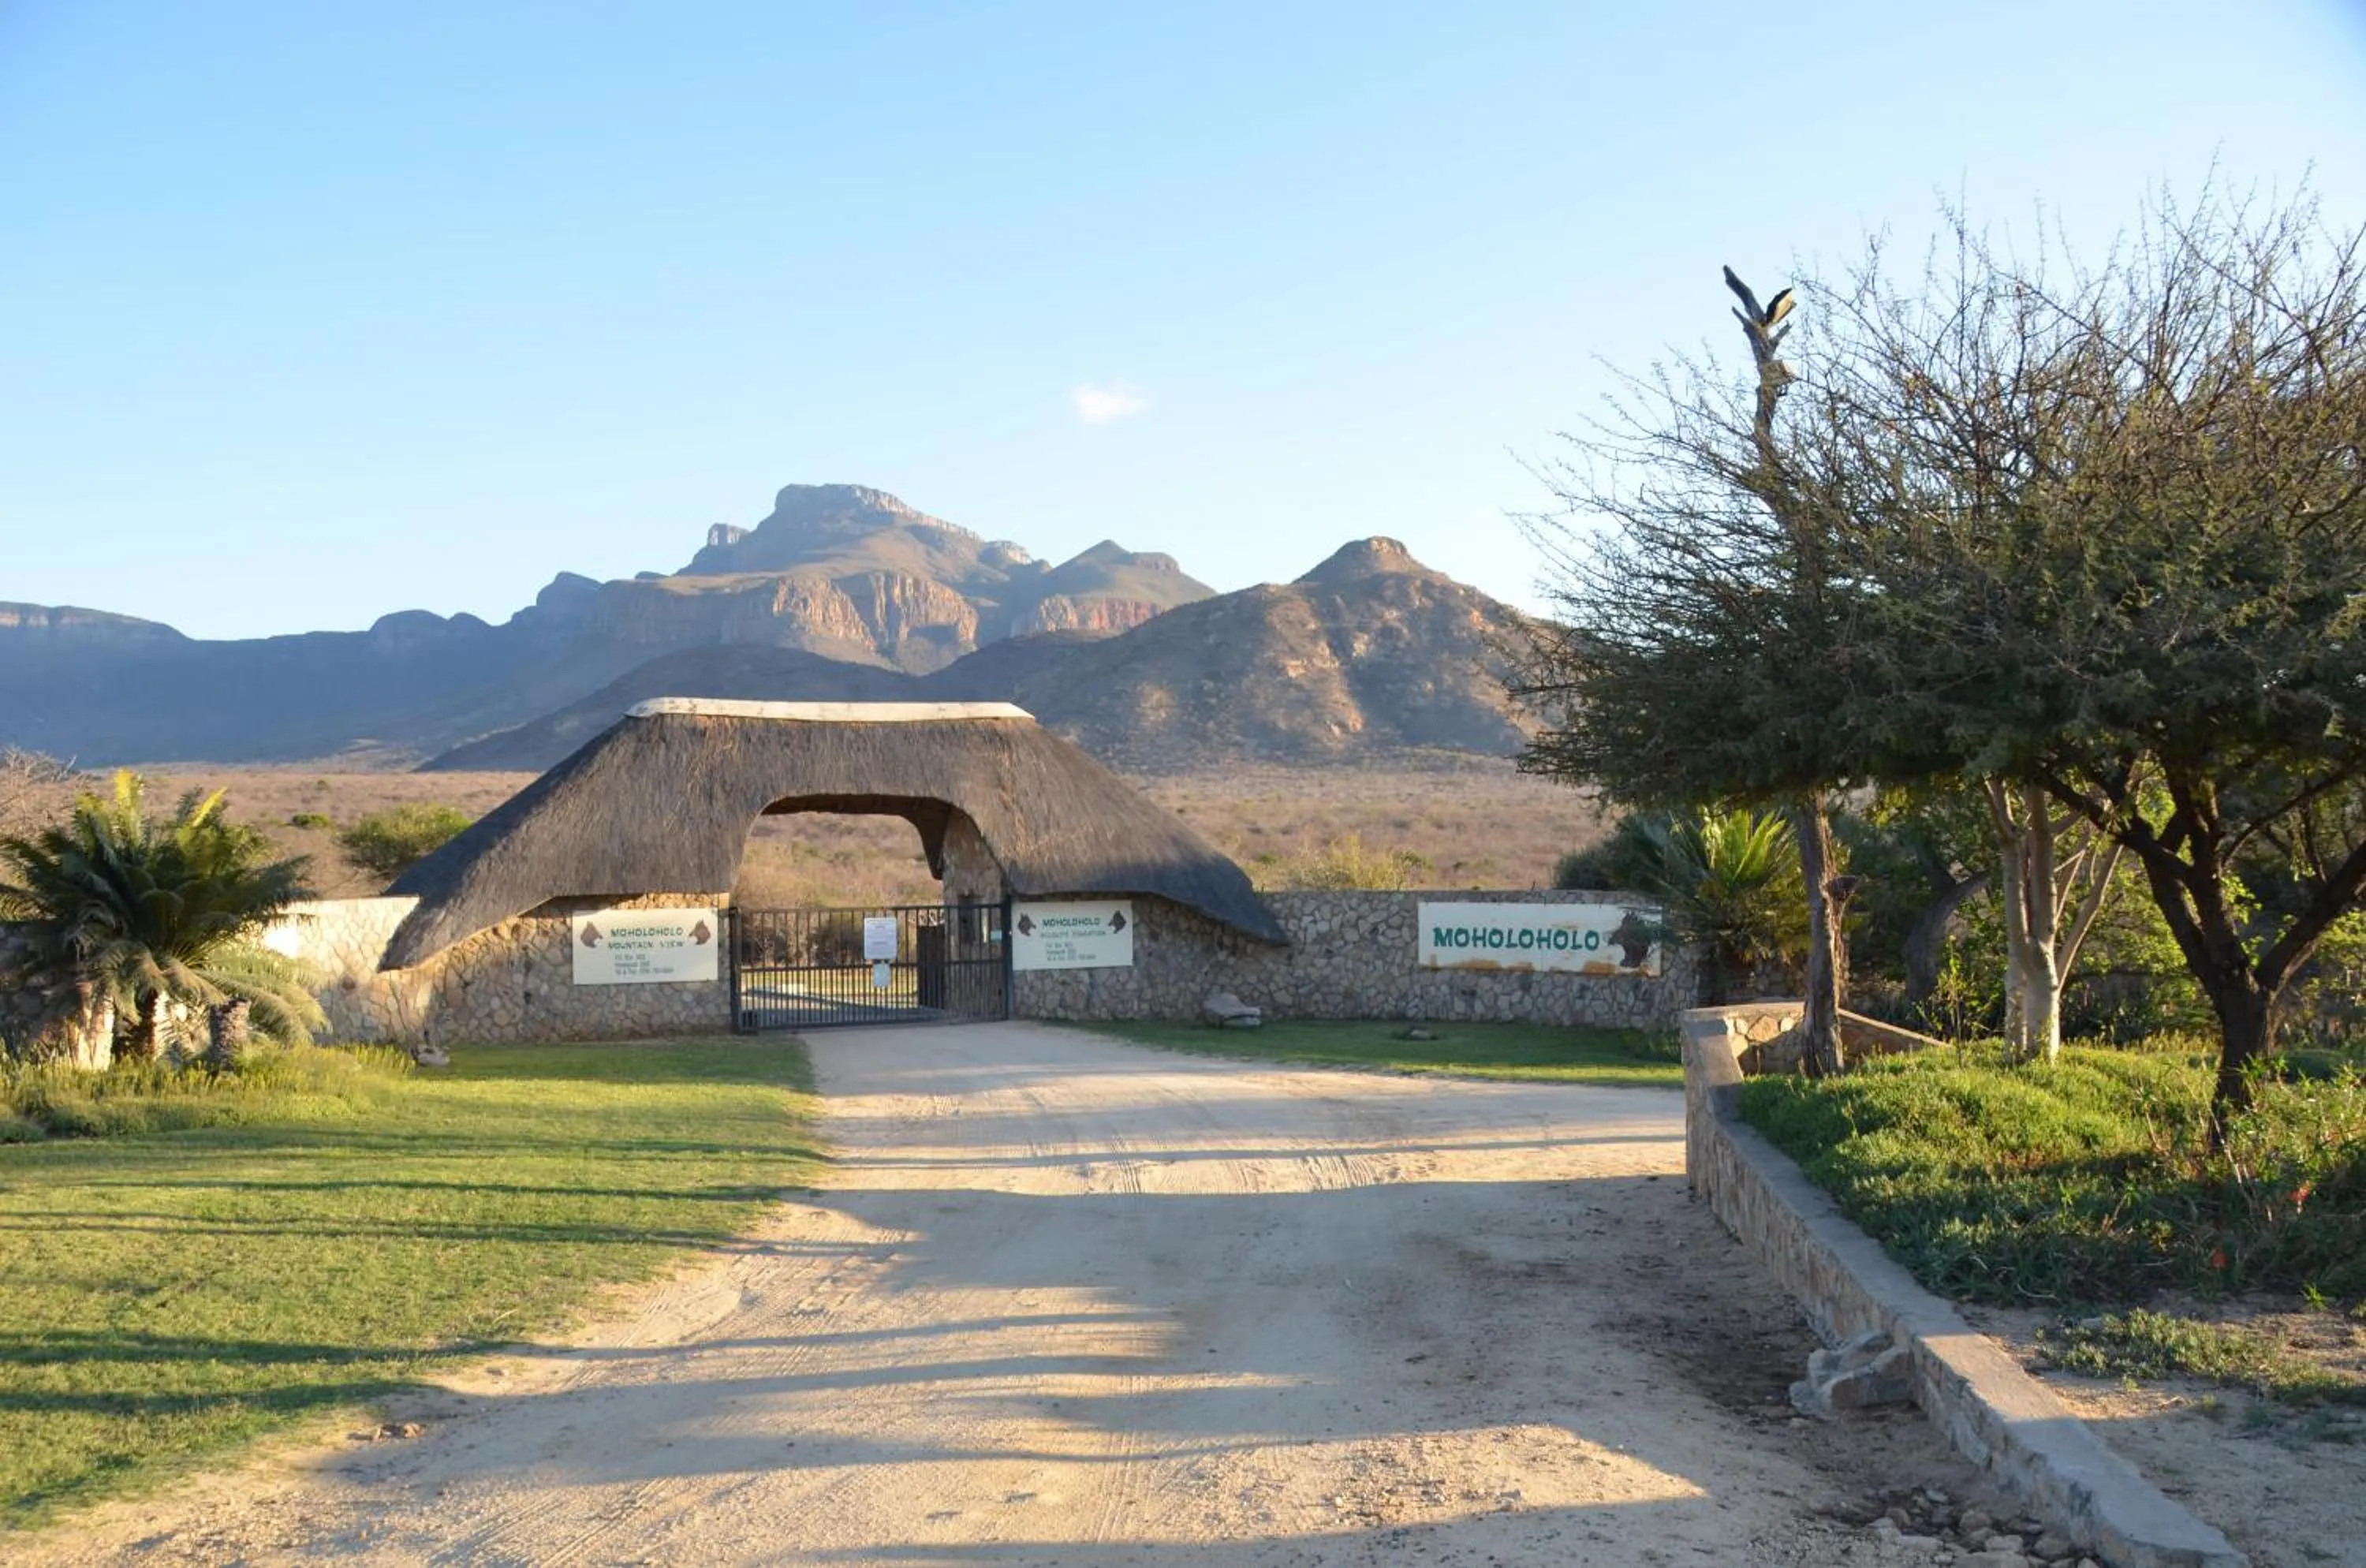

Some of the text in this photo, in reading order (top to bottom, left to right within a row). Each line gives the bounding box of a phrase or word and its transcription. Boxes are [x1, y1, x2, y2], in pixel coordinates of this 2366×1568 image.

[1043, 917, 1100, 927] MOHOLOHOLO
[610, 927, 684, 937] MOHOLOHOLO
[1433, 927, 1599, 951] MOHOLOHOLO
[608, 941, 654, 950] MOUNTAIN
